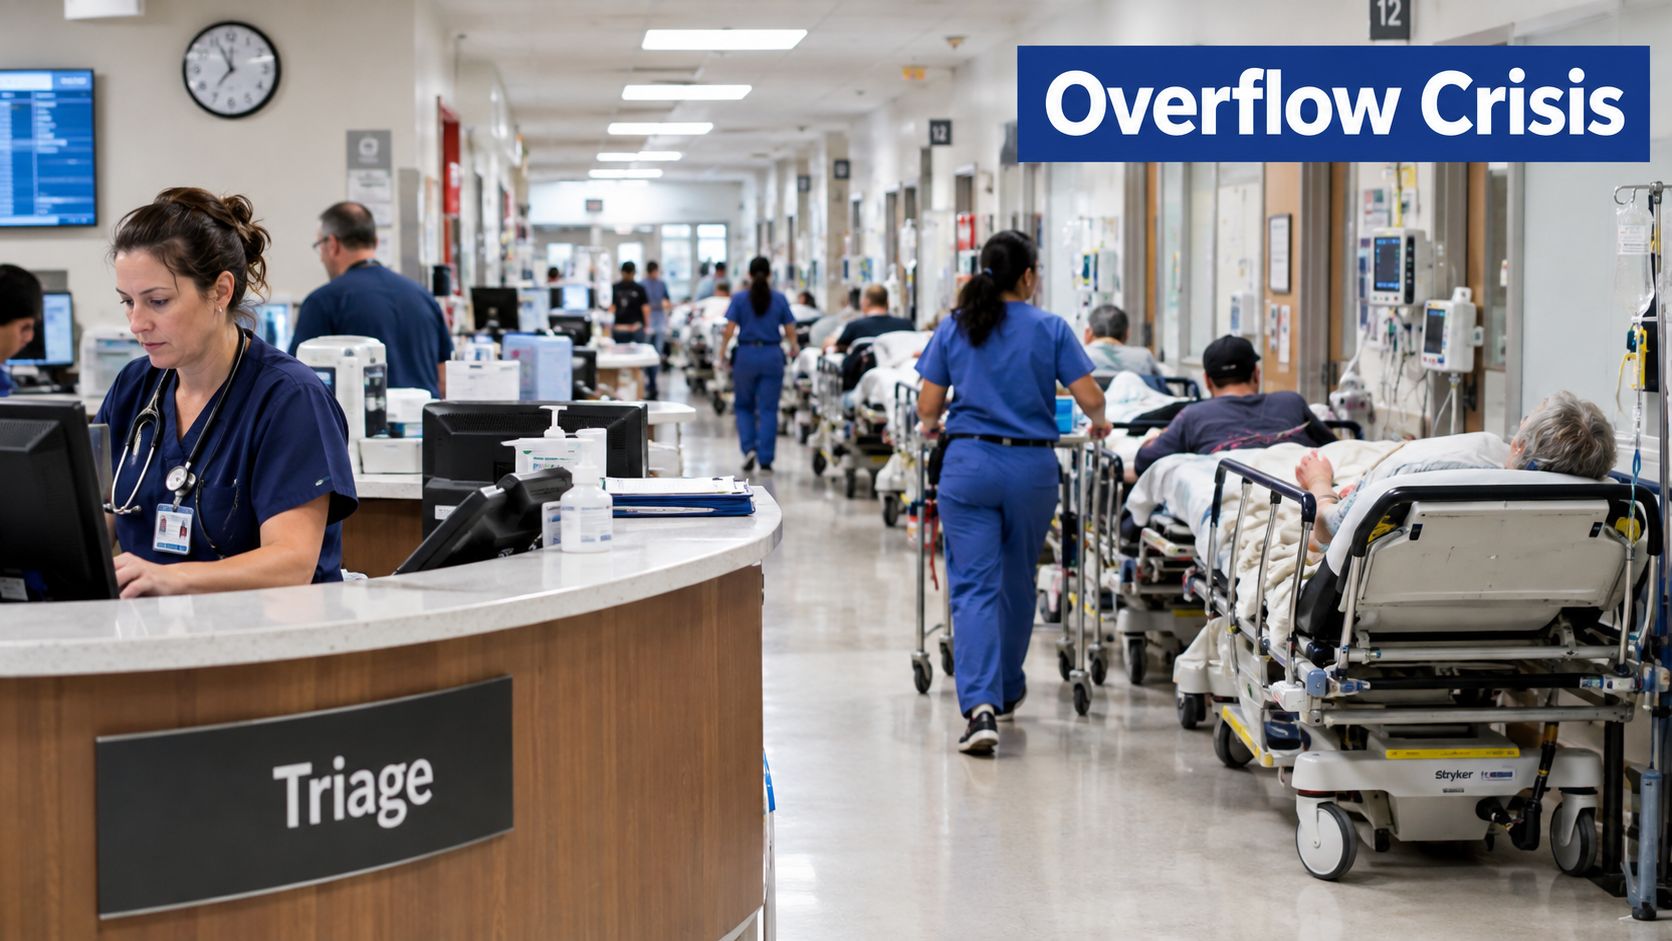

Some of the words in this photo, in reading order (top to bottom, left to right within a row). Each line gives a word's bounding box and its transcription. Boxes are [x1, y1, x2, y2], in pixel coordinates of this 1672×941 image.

[1377, 0, 1402, 26] 12
[1435, 769, 1474, 782] Stryker
[273, 755, 433, 829] Triage
